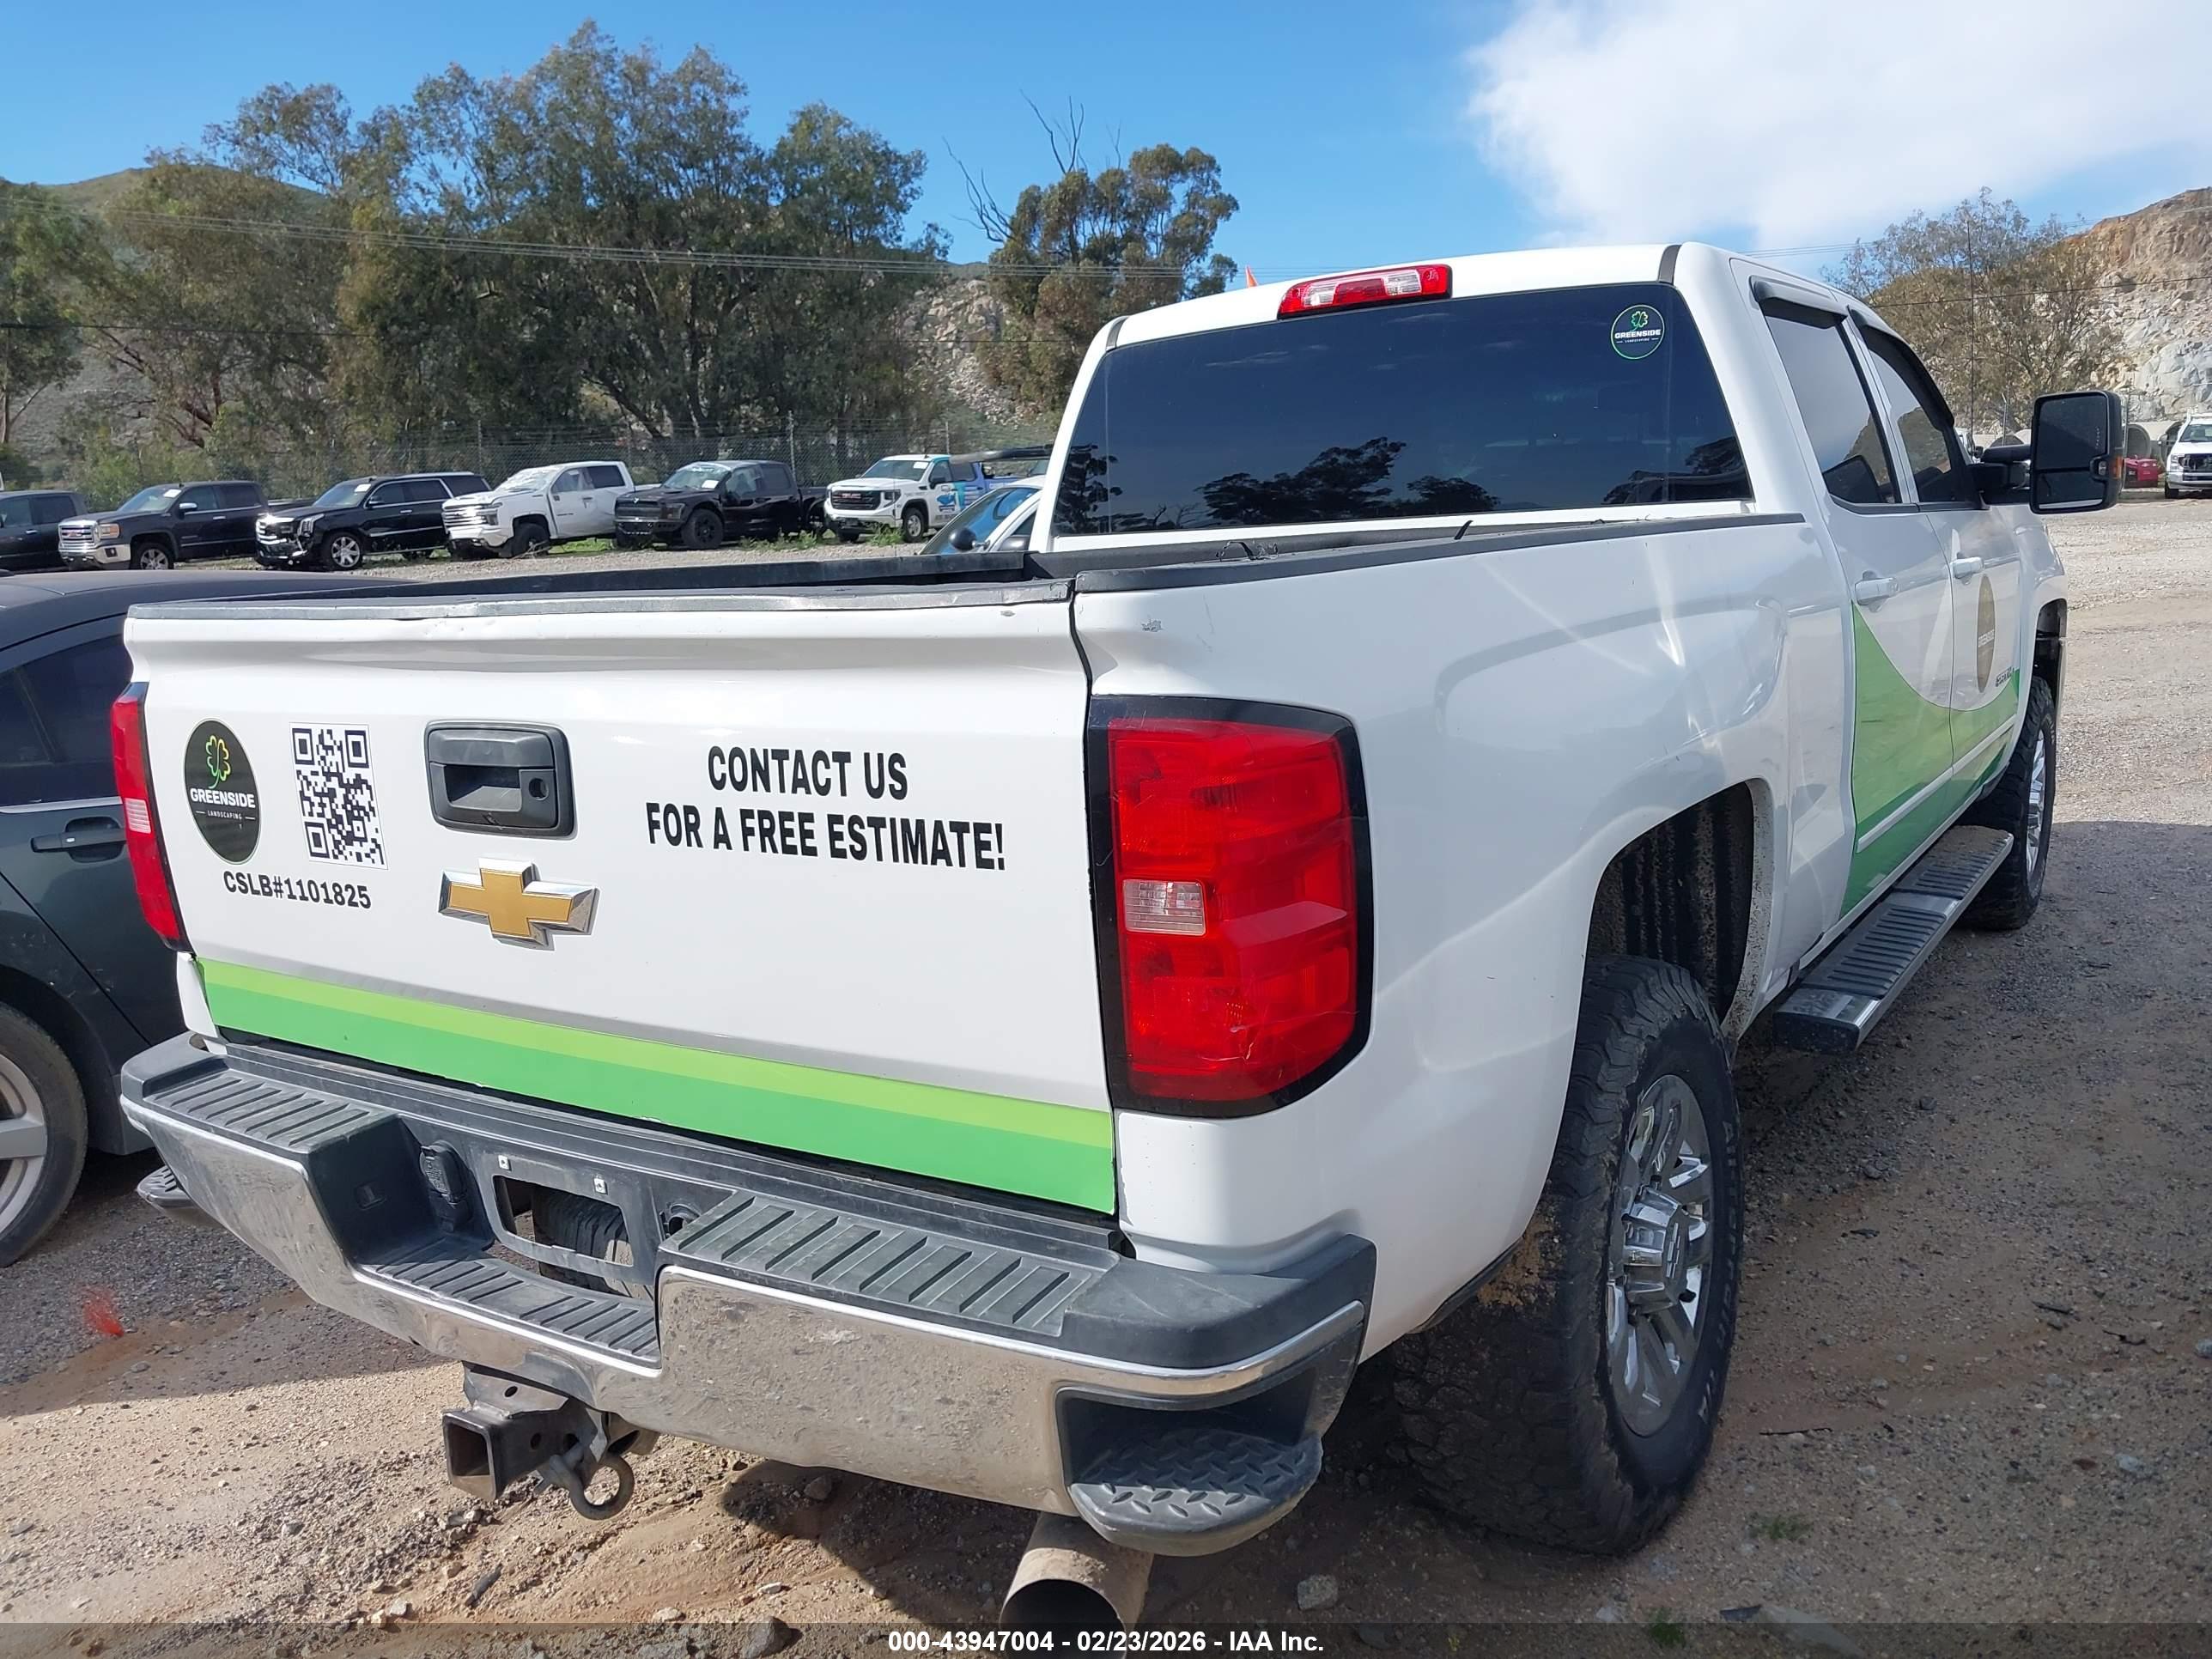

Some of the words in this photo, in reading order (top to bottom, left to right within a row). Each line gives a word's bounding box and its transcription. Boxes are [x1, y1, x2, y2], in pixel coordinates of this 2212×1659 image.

[1614, 329, 1662, 339] GREENSIDE
[708, 745, 852, 797] CONTACT
[863, 752, 908, 800] US
[190, 787, 255, 808] GREENSIDE
[207, 810, 242, 820] LANDSCAPING
[646, 803, 703, 848] FOR
[713, 806, 732, 851] A
[739, 809, 818, 857] FREE
[827, 813, 1006, 871] ESTIMATE!
[223, 871, 372, 909] CSLB#1101825
